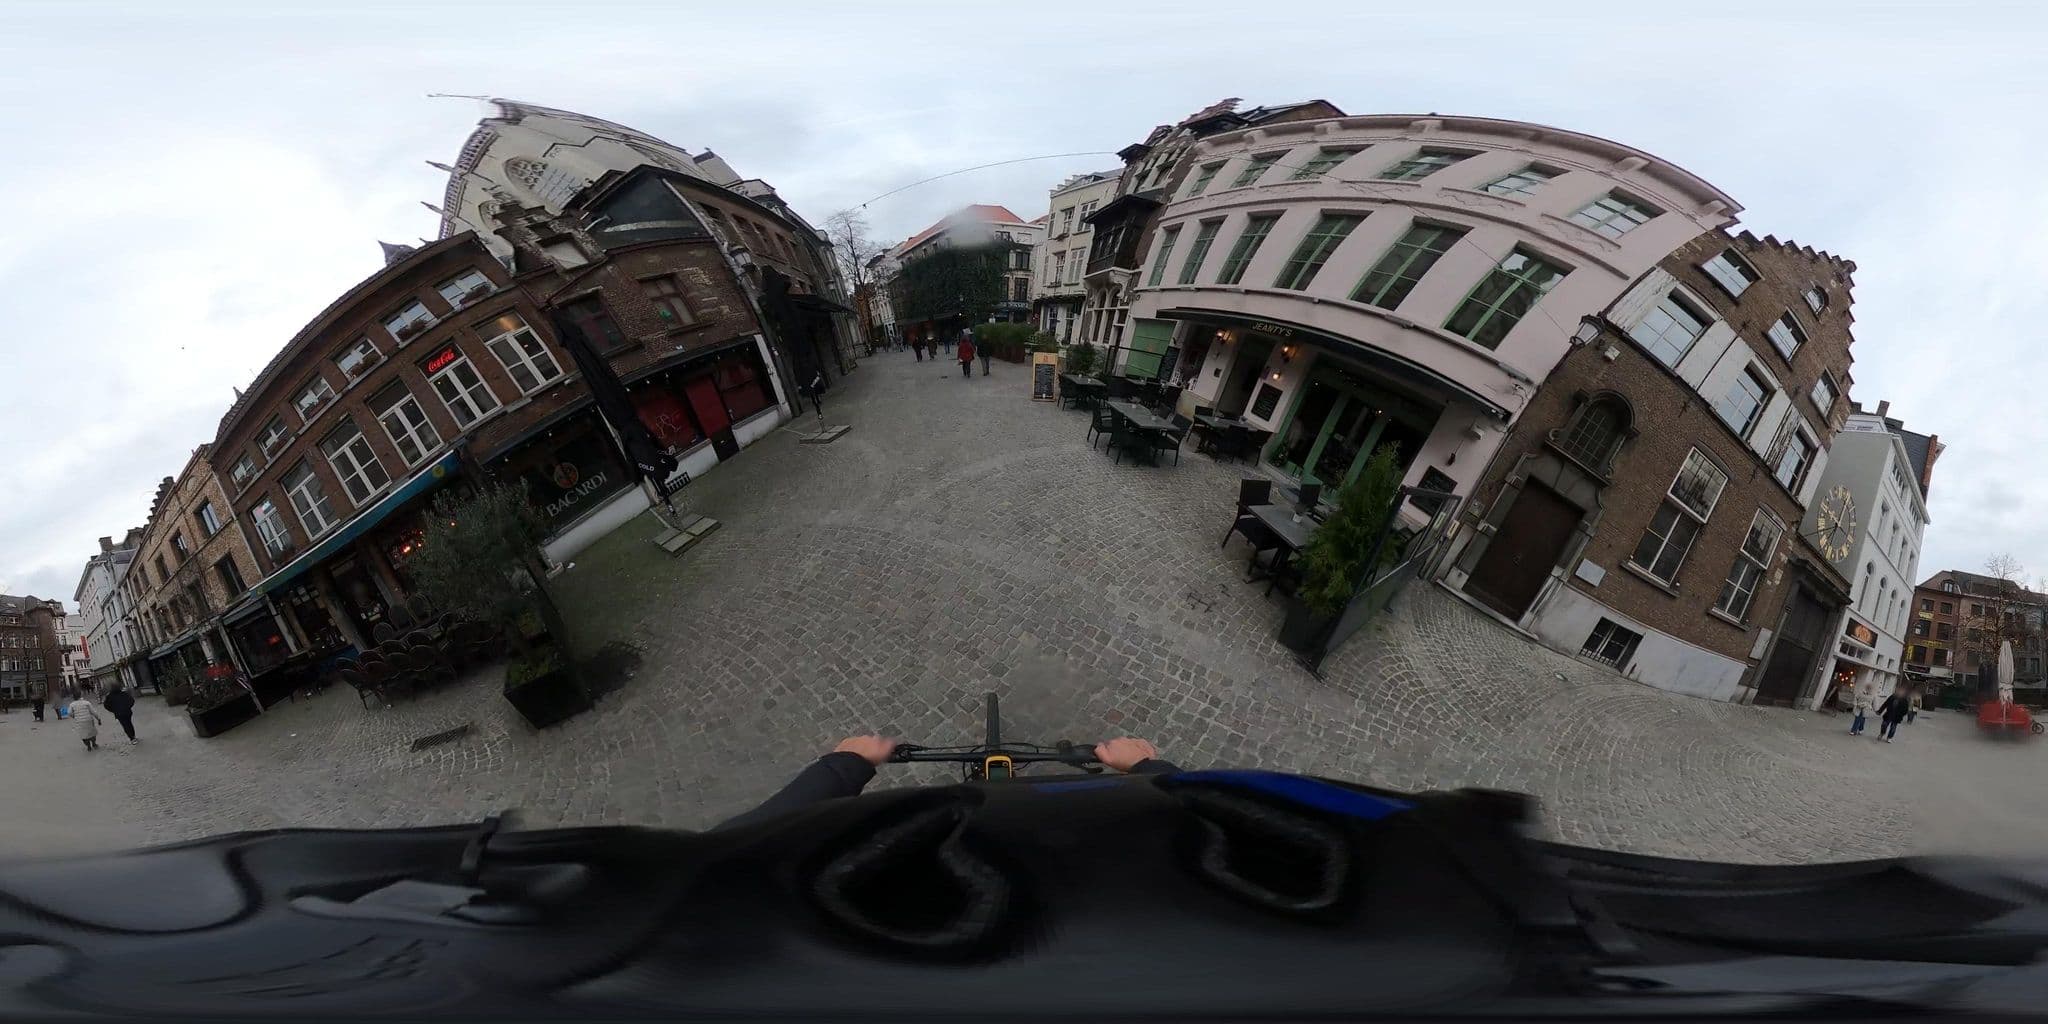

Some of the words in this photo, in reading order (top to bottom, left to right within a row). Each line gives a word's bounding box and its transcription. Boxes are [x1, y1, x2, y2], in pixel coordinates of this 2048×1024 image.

[1253, 322, 1292, 337] JEANTY'S
[428, 347, 455, 372] Coca-Cola
[546, 471, 607, 517] BACARDI
